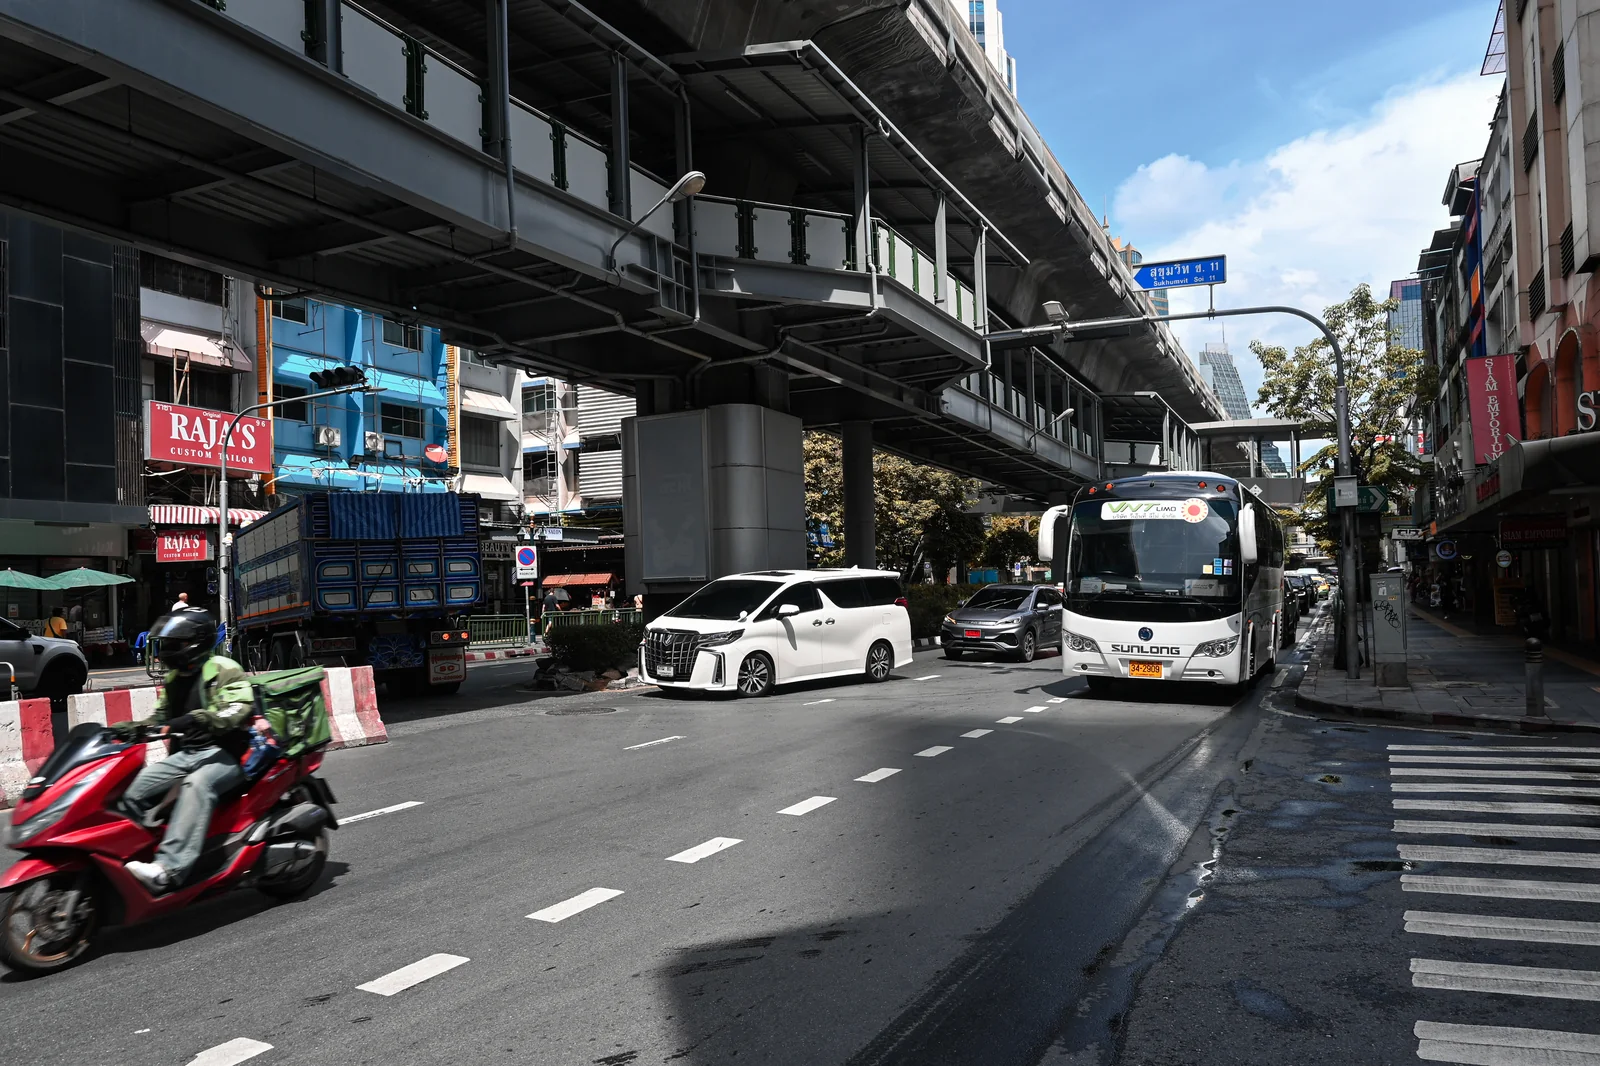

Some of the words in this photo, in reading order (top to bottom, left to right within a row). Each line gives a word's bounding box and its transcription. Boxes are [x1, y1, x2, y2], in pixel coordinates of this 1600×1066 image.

[1150, 263, 1190, 281] สุขุมวิท
[1210, 262, 1219, 272] 11
[1153, 278, 1188, 287] Sukhumvit
[1485, 358, 1498, 391] SIAM
[202, 411, 222, 419] Original
[169, 412, 256, 450] RAJA'S
[170, 447, 212, 458] CUSTOM
[218, 452, 254, 464] TAILOR
[1107, 501, 1161, 513] VNT
[1503, 529, 1522, 541] SIAM
[1524, 527, 1566, 540] EMPORIUM
[164, 534, 200, 552] RAJA'S
[481, 542, 510, 553] BEAUTY
[1111, 643, 1181, 656] SUNLONG
[1131, 664, 1160, 673] 34-2909
